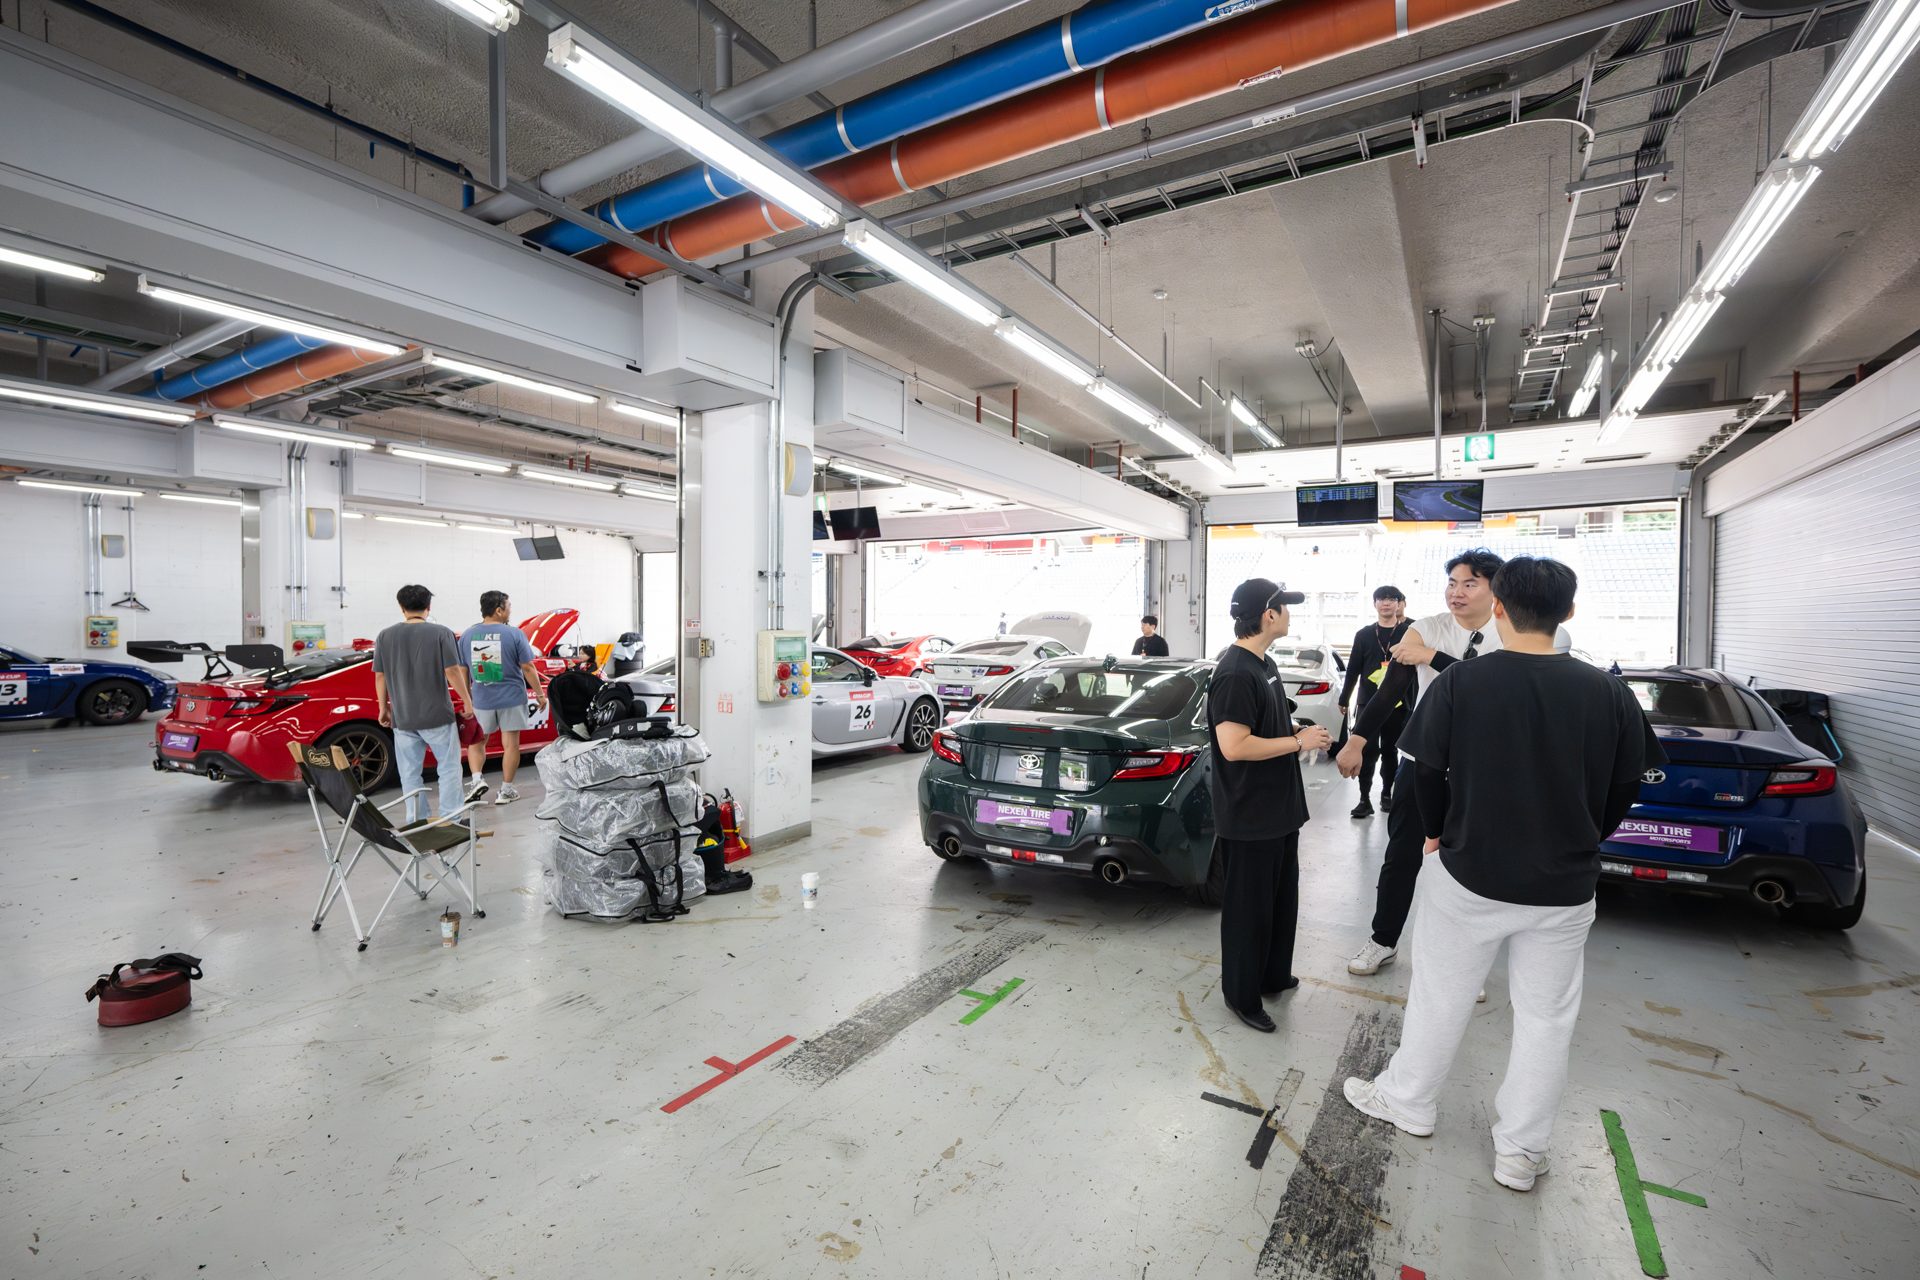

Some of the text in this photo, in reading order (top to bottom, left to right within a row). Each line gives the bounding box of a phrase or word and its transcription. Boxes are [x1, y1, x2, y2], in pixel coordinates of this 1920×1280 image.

[855, 704, 871, 719] 26
[998, 805, 1051, 820] NEXEN TIRE
[1617, 821, 1692, 838] NEXEN TIRE
[1649, 836, 1692, 845] MOTORSPORTS
